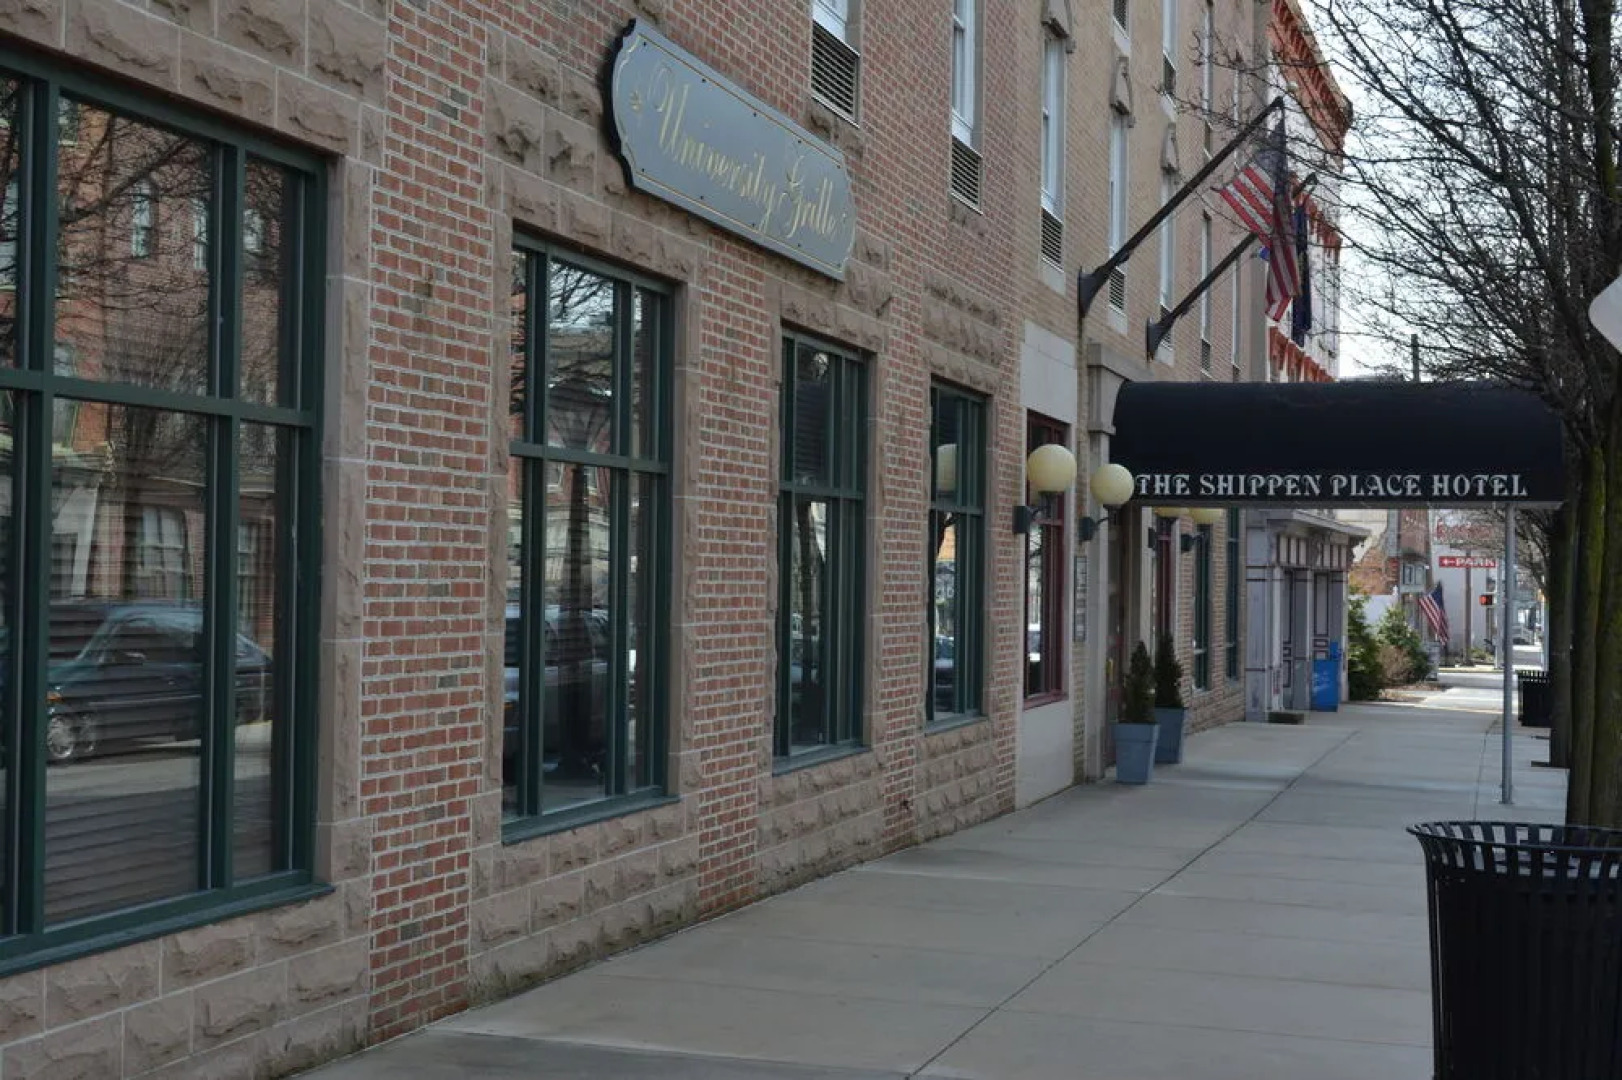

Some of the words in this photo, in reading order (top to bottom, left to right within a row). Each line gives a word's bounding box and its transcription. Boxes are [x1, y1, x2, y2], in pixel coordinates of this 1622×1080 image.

[648, 62, 777, 233] University
[1136, 474, 1191, 496] THE
[1199, 473, 1321, 496] SHIPPEN
[1330, 474, 1423, 497] PLACE
[1431, 474, 1529, 497] HOTEL
